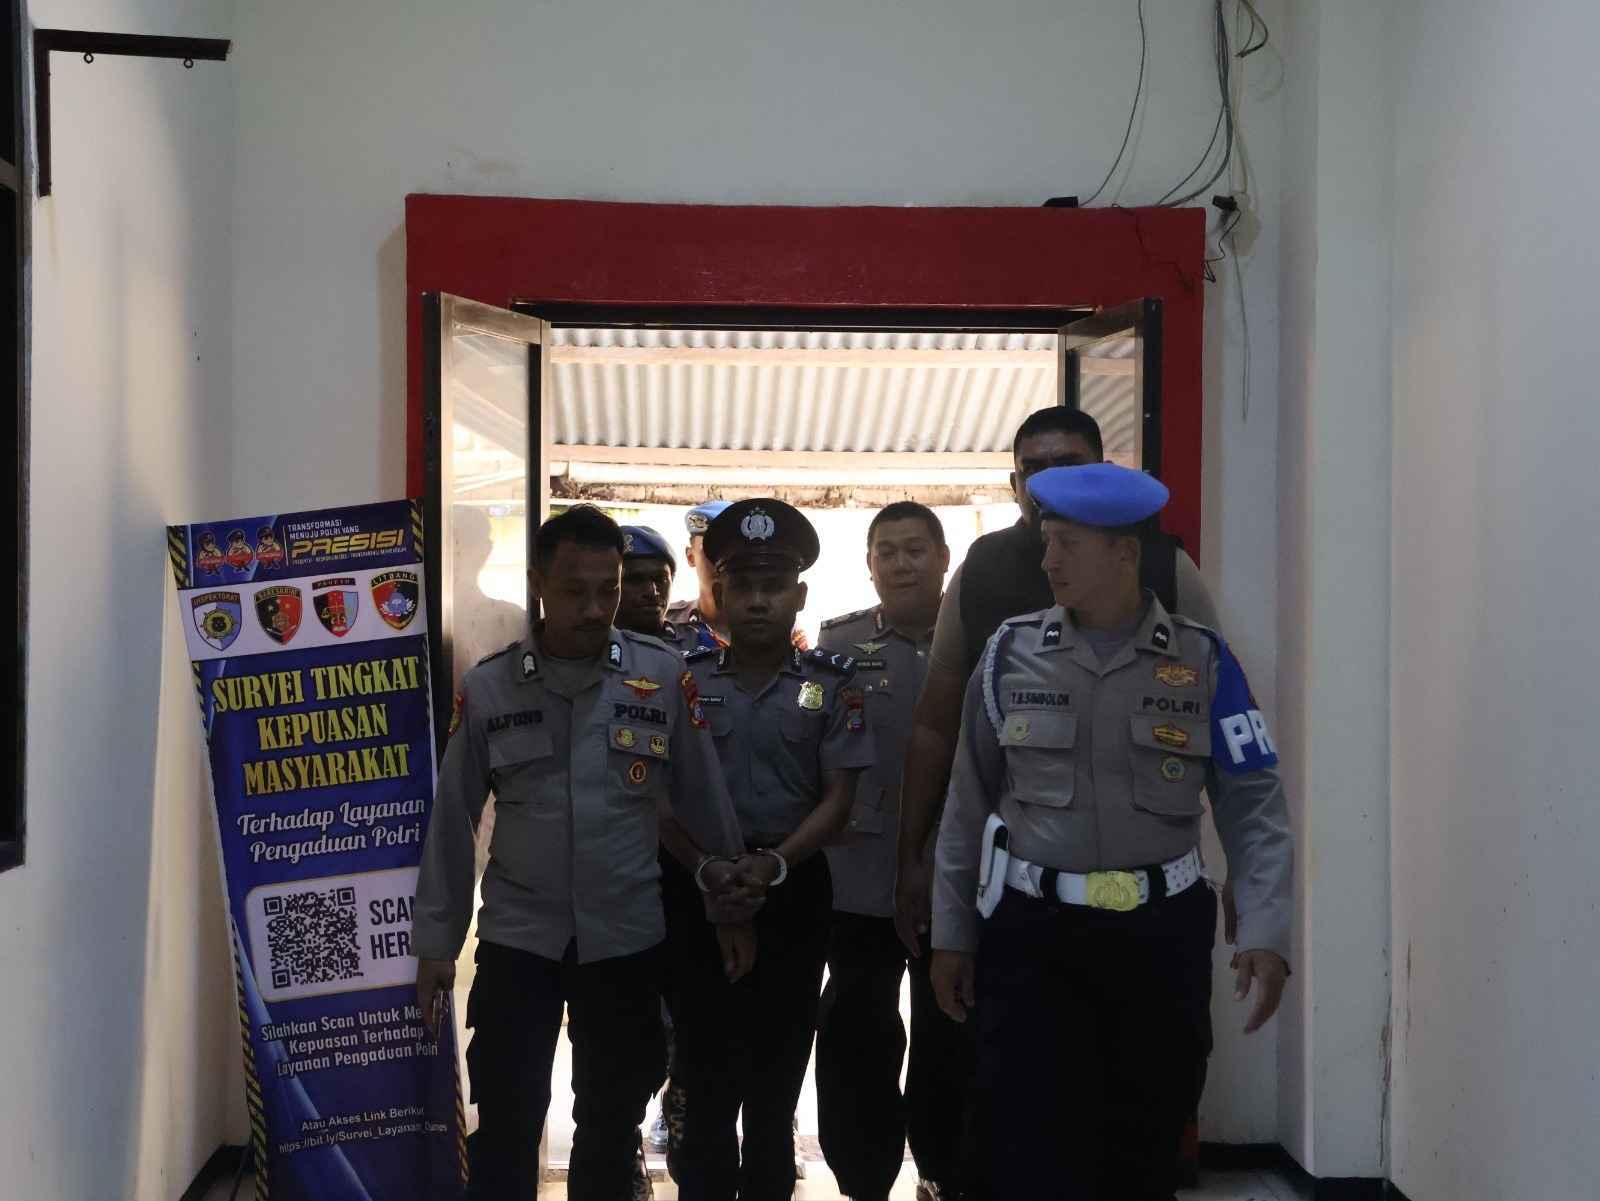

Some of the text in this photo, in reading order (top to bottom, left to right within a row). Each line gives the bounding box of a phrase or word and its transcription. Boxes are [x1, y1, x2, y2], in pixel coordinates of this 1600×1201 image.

[288, 519, 342, 532] TRANSFORMASI
[290, 525, 360, 540] MENUJU POLRI YANG
[291, 528, 405, 559] PRESISI
[211, 655, 420, 713] SURVEI TINGKAT
[486, 709, 544, 733] ALFONS
[613, 702, 668, 725] POLRI
[1142, 696, 1200, 715] POLRI
[256, 703, 389, 751] KEPUASAN
[243, 743, 411, 797] MASYARAKAT
[236, 799, 425, 836] Terhadap Layanan
[249, 822, 421, 864] Pengaduan Polri
[261, 1018, 318, 1042] Silahkan
[320, 1015, 355, 1031] Scan
[358, 1007, 400, 1027] Untuk
[289, 1024, 424, 1056] Kepuasan Terhadap
[276, 1040, 439, 1079] Layanan Pengaduan Polri
[302, 1119, 326, 1132] Atau
[328, 1113, 361, 1128] Akses
[363, 1108, 387, 1122] Link
